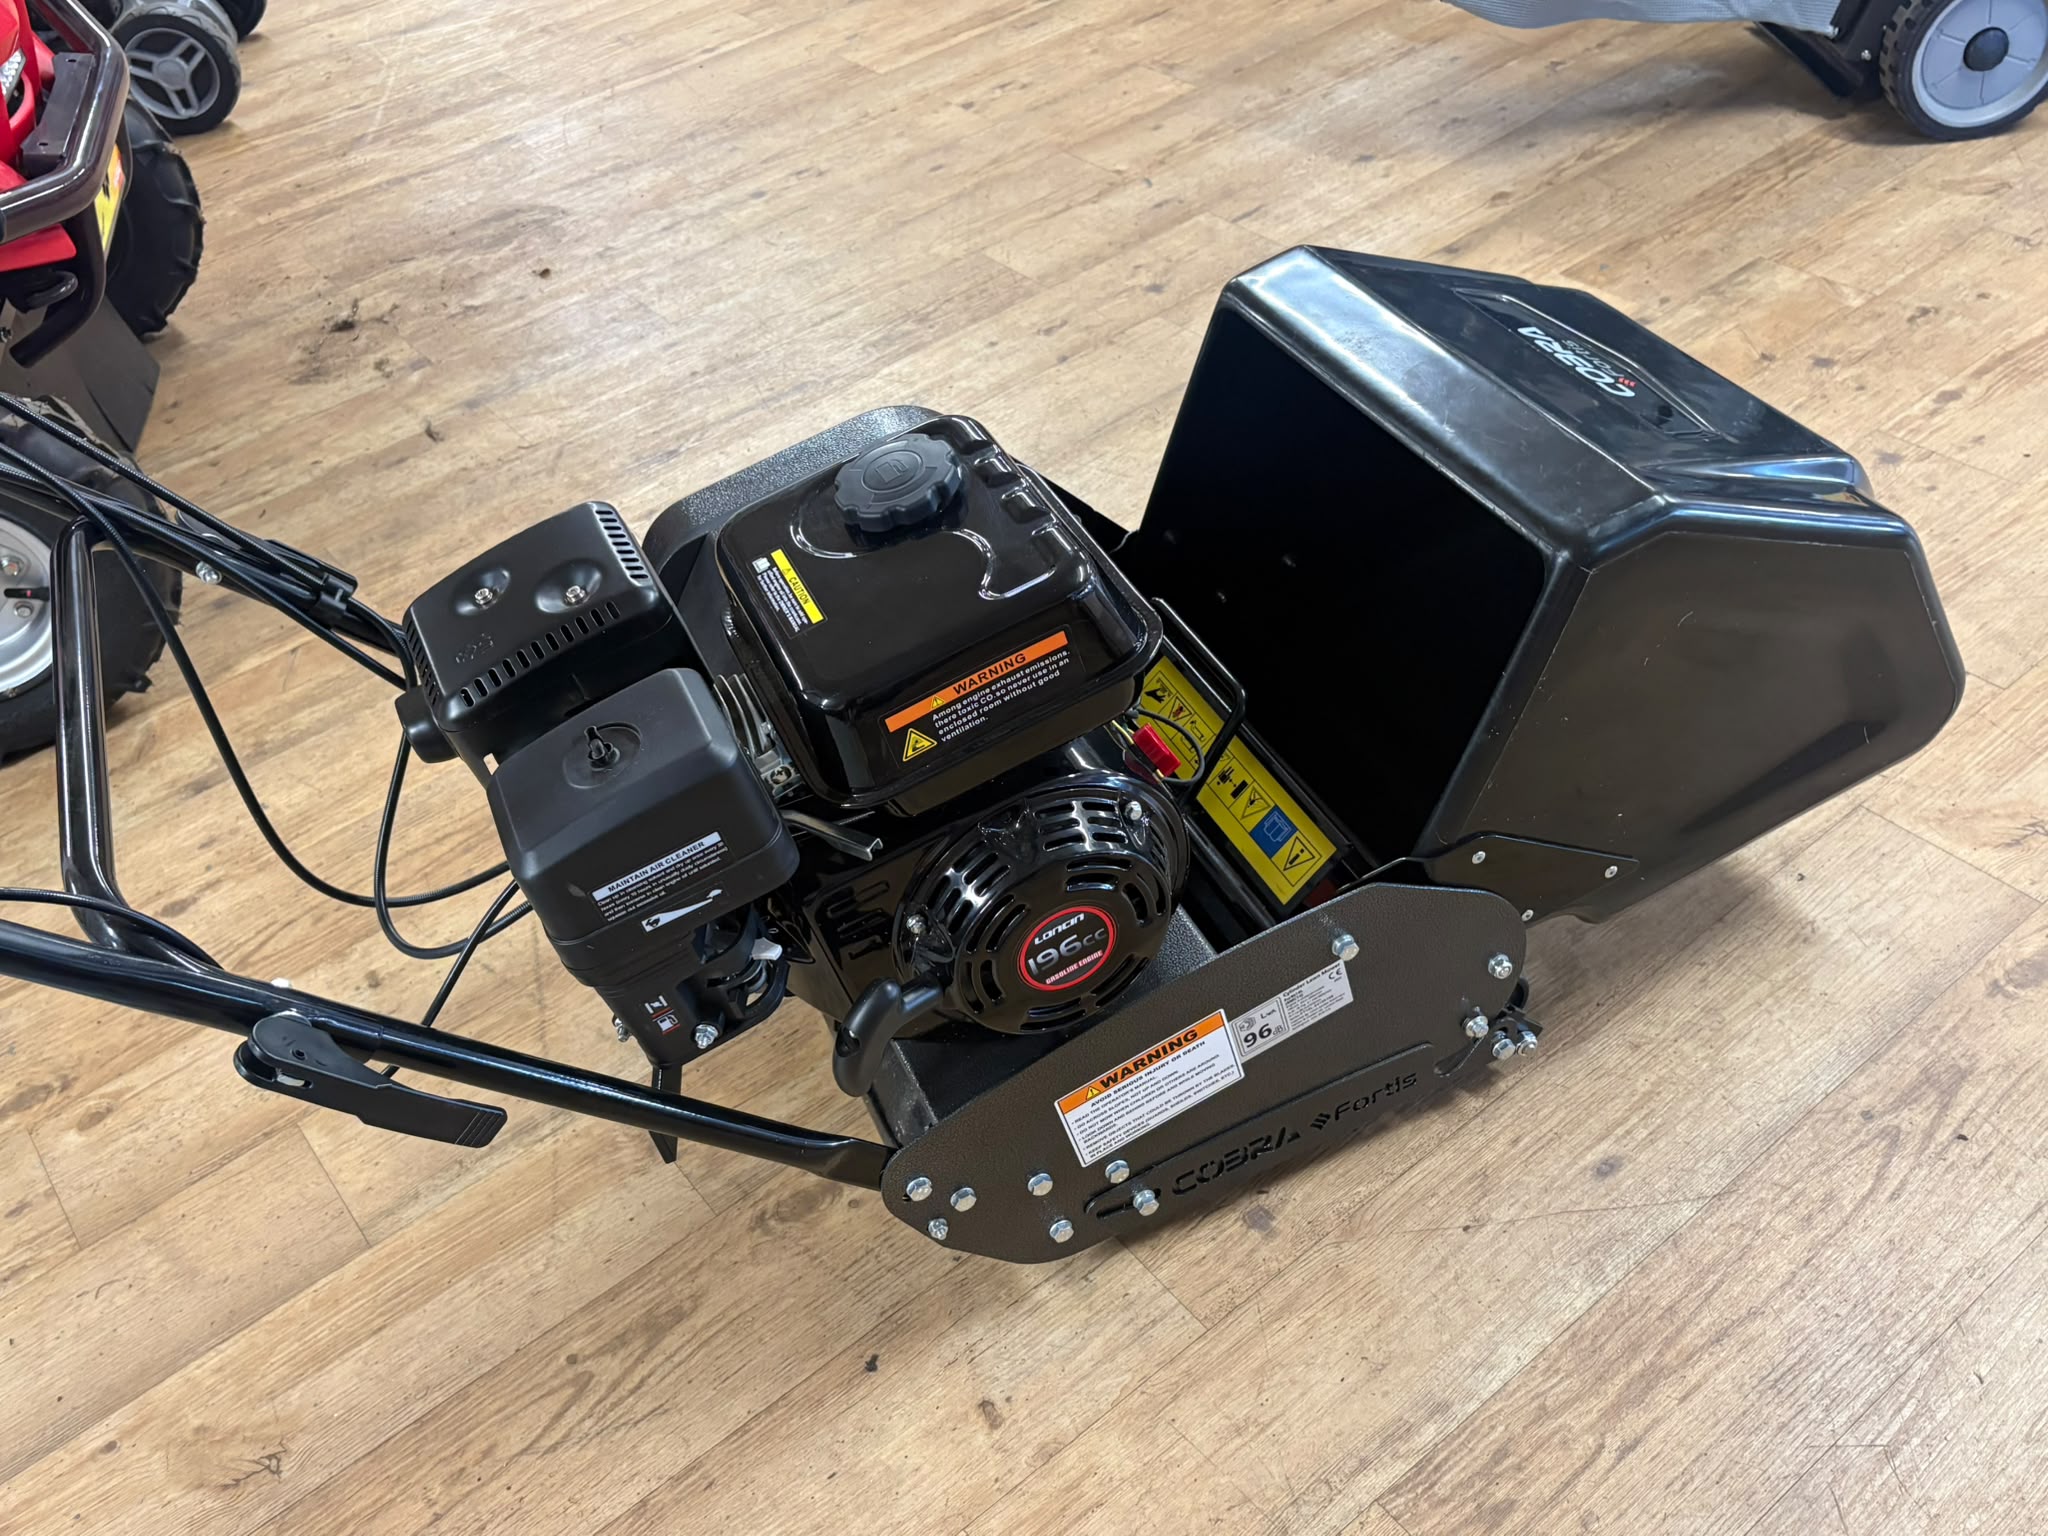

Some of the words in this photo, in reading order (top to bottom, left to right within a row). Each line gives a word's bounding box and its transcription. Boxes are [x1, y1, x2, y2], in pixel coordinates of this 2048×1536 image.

[1517, 326, 1635, 397] COBRA
[789, 577, 811, 605] CAUTION
[931, 701, 962, 721] Among
[961, 686, 991, 706] engine
[990, 669, 1024, 690] exhaust
[1024, 647, 1070, 674] emissions.
[934, 712, 957, 727] there
[957, 700, 979, 716] toxic
[1006, 675, 1031, 691] never
[1031, 667, 1048, 679] use
[1048, 661, 1057, 670] in
[1057, 656, 1069, 666] an
[937, 710, 978, 734] enclosed
[978, 698, 1002, 713] room
[1002, 680, 1036, 701] without
[1037, 669, 1060, 685] good
[953, 653, 1026, 695] WARNING
[940, 713, 989, 742] ventilation.
[608, 868, 649, 893] MAINTAIN
[650, 862, 664, 875] AIR
[665, 841, 705, 865] CLEANER
[1028, 928, 1106, 975] 196cc
[1046, 962, 1079, 985] GASOLINE
[1079, 950, 1104, 966] ENGINE
[1099, 1028, 1198, 1089] WARNING
[1243, 1023, 1272, 1048] 96
[1090, 1092, 1112, 1107] AVOID
[1113, 1075, 1143, 1094] SERIOUS
[1144, 1060, 1169, 1077] INJURY
[1171, 1053, 1181, 1062] OR
[1182, 1040, 1205, 1056] DEATH
[1172, 1127, 1301, 1195] COBRA
[1335, 1073, 1417, 1121] Fortis
